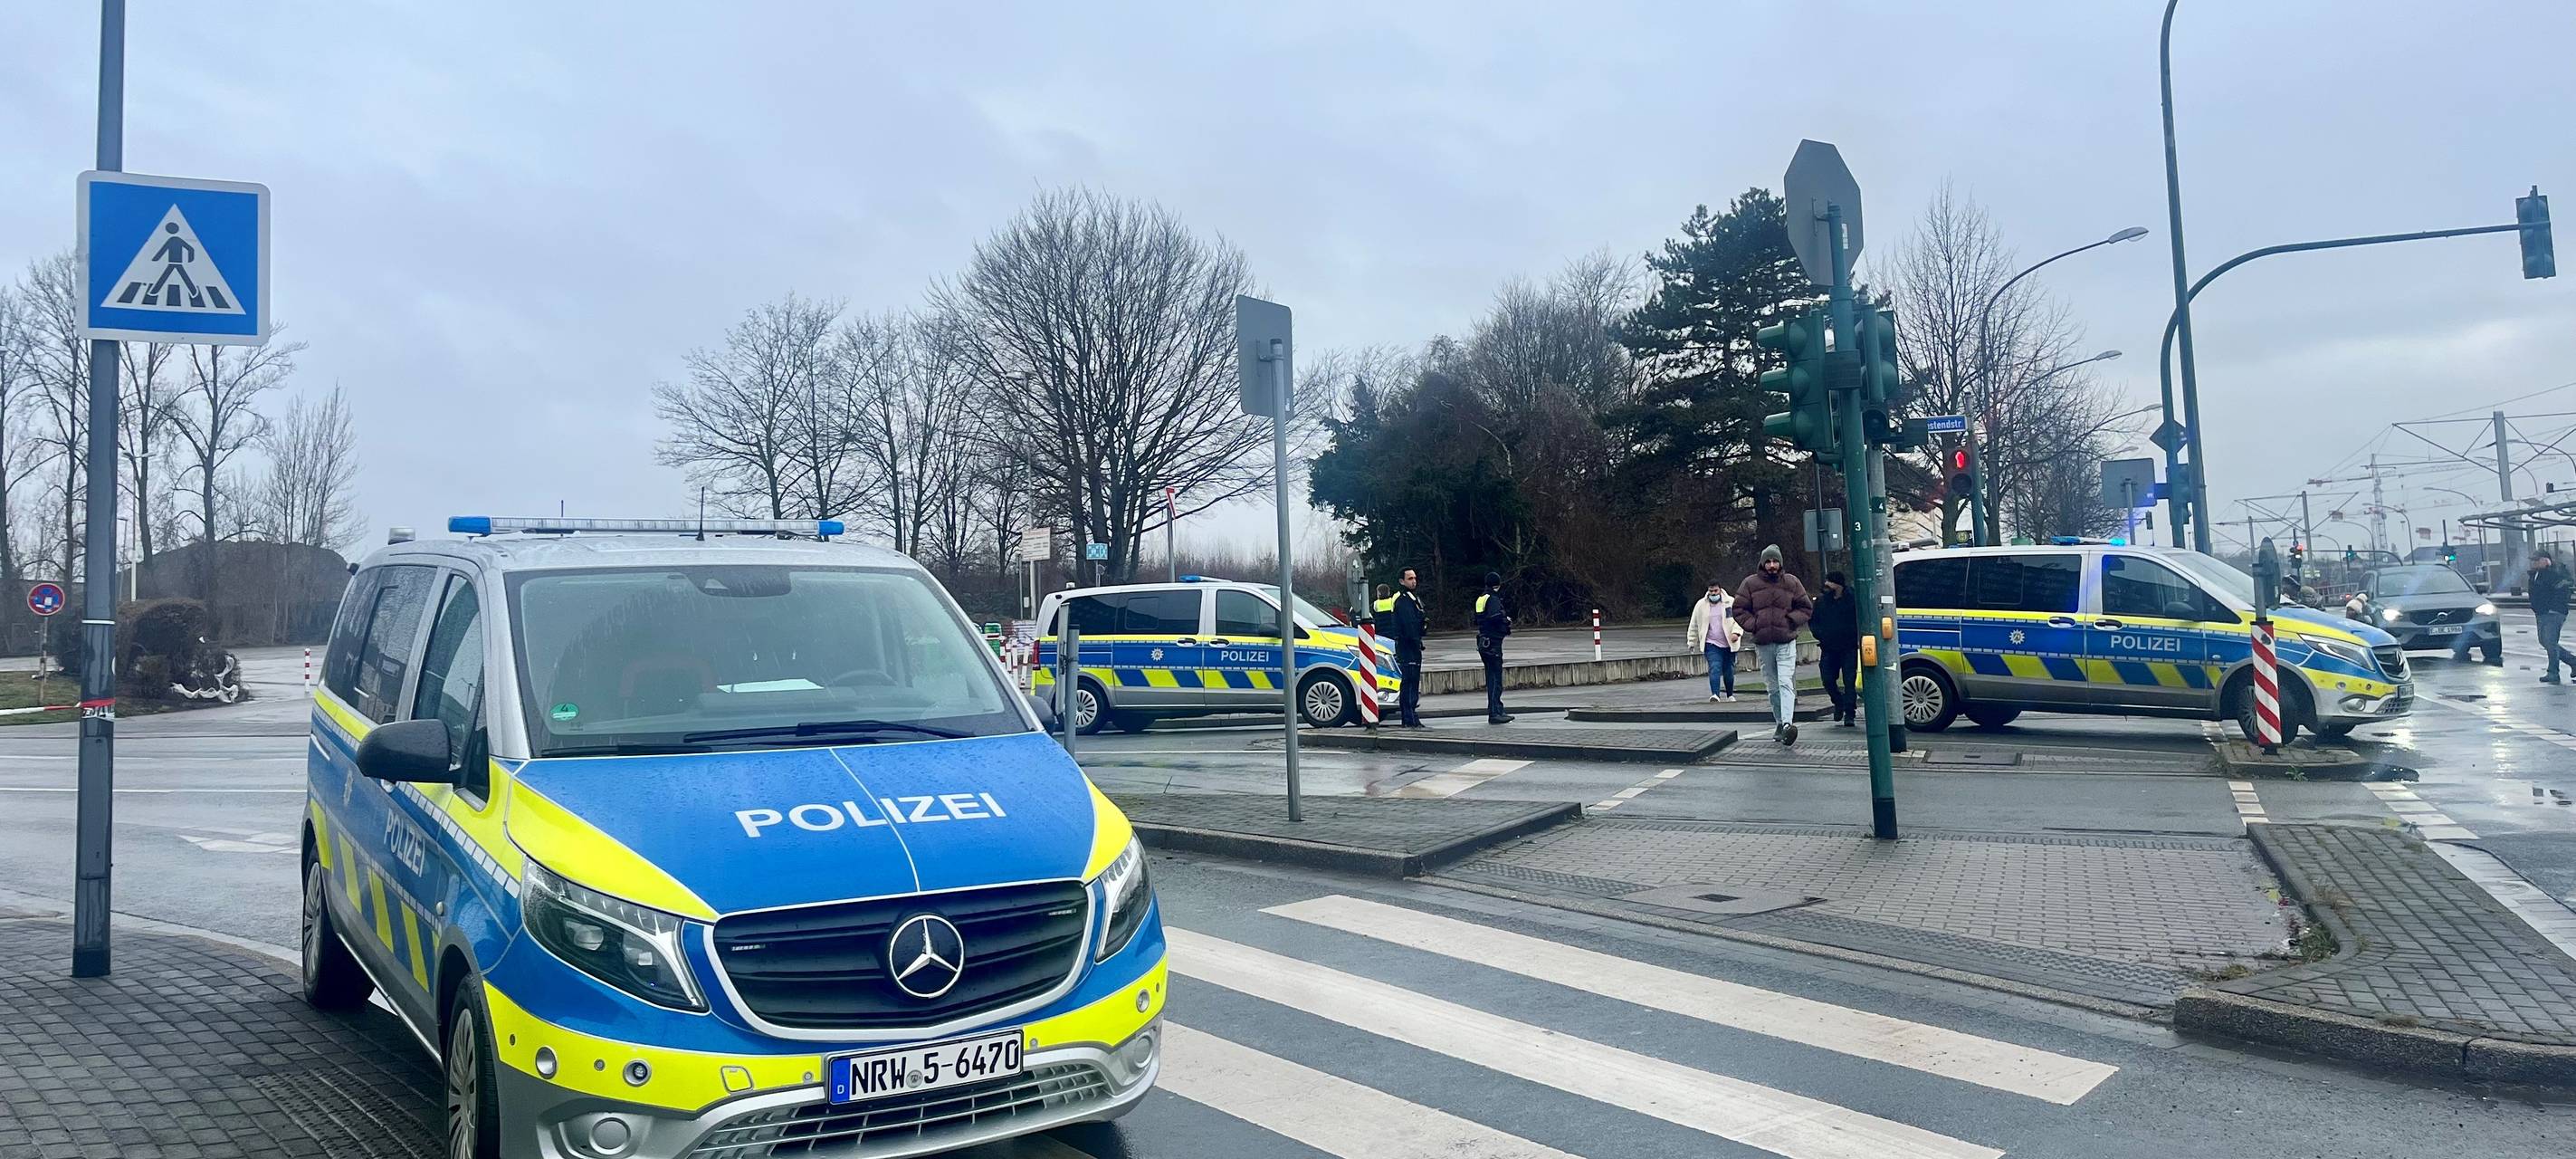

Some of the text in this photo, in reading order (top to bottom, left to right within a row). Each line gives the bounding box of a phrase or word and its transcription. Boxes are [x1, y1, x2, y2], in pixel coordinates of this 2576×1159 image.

[1855, 522, 1861, 532] 3
[2110, 635, 2180, 652] POLIZEI
[1220, 650, 1269, 662] POLIZEI
[560, 704, 568, 712] 4
[734, 792, 1007, 838] POLIZEI
[384, 808, 425, 877] POLIZEI
[851, 1039, 1019, 1096] NRW 5-6470
[836, 1084, 844, 1095] D
